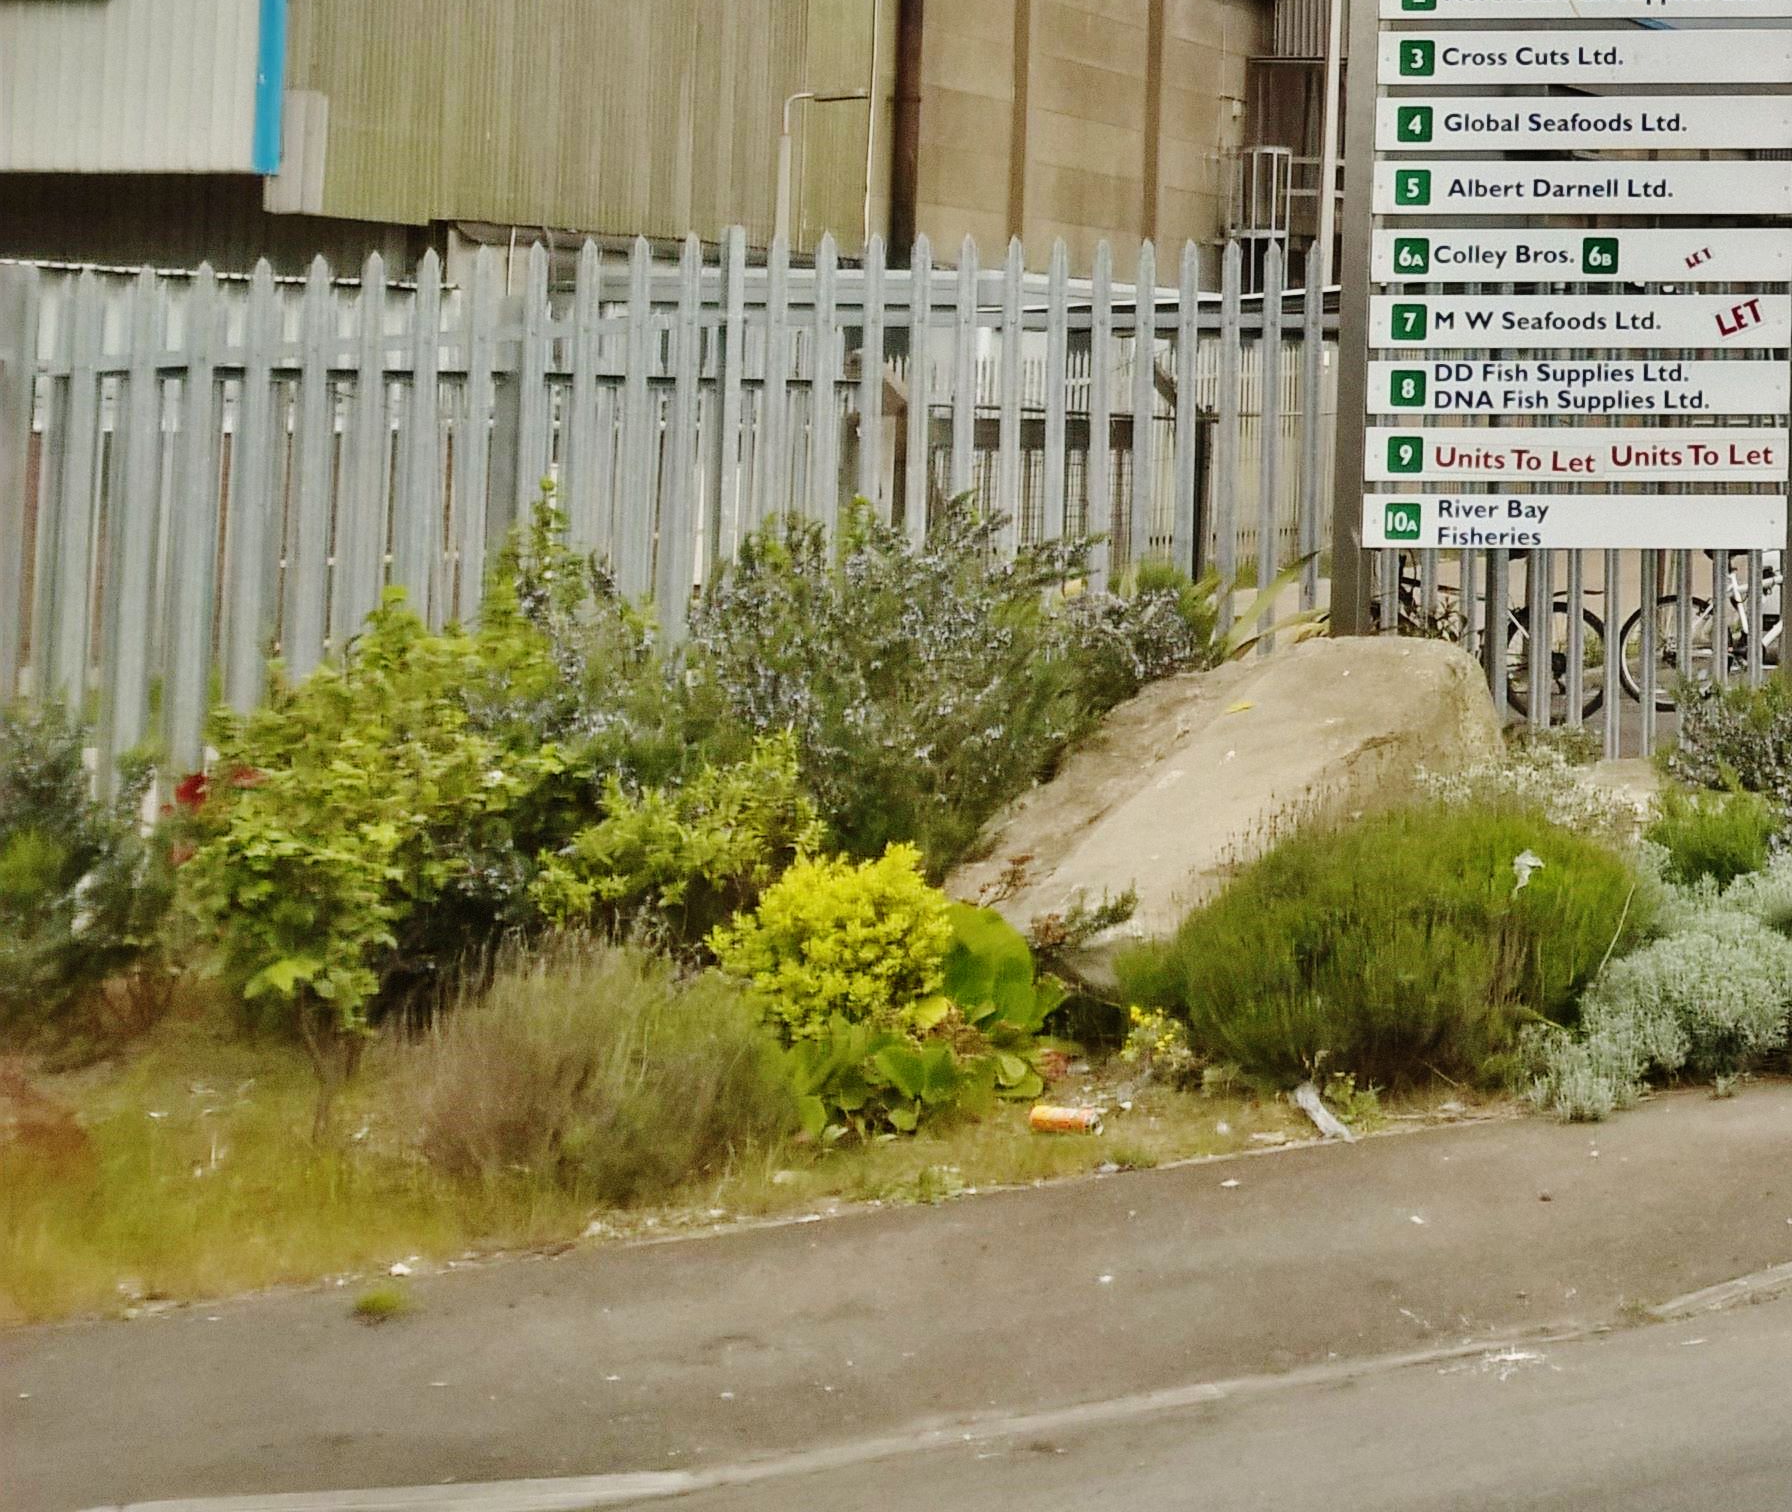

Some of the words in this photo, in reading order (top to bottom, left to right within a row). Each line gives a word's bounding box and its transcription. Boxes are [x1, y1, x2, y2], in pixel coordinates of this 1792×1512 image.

[1410, 49, 1424, 68] 3
[1442, 49, 1507, 66] Cross
[1516, 48, 1569, 65] Cuts
[1578, 47, 1623, 65] Ltd.
[1408, 115, 1423, 133] 4
[1444, 114, 1519, 132] Global
[1529, 113, 1632, 131] Seafoods
[1641, 113, 1687, 131] Ltd.
[1406, 179, 1420, 197] 5
[1448, 179, 1524, 197] Albert
[1533, 179, 1618, 197] Darnell
[1627, 179, 1673, 197] Ltd.
[1434, 246, 1507, 268] Colley
[1516, 245, 1574, 264] Bros.
[1685, 247, 1712, 269] LET
[1403, 312, 1416, 331] 7
[1435, 312, 1454, 330] M
[1465, 311, 1493, 329] W
[1502, 310, 1606, 330] Seafoods
[1615, 311, 1661, 330] Ltd.
[1715, 299, 1764, 336] LET
[1402, 379, 1415, 398] 8
[1435, 364, 1472, 382] DD
[1483, 364, 1529, 382] Fish
[1537, 364, 1634, 387] Supplies
[1643, 364, 1689, 382] Ltd.
[1435, 391, 1494, 409] DNA
[1503, 391, 1548, 409] Fish
[1559, 391, 1655, 413] Supplies
[1664, 391, 1709, 409] Ltd.
[1400, 445, 1413, 464] 9
[1435, 447, 1504, 469] Units
[1510, 449, 1541, 470] To
[1552, 451, 1595, 472] Let
[1611, 445, 1682, 467] Units
[1687, 444, 1718, 465] To
[1729, 444, 1773, 465] Let
[1439, 500, 1498, 518] River
[1508, 500, 1549, 523] Bay
[1438, 528, 1541, 545] Fisheries
